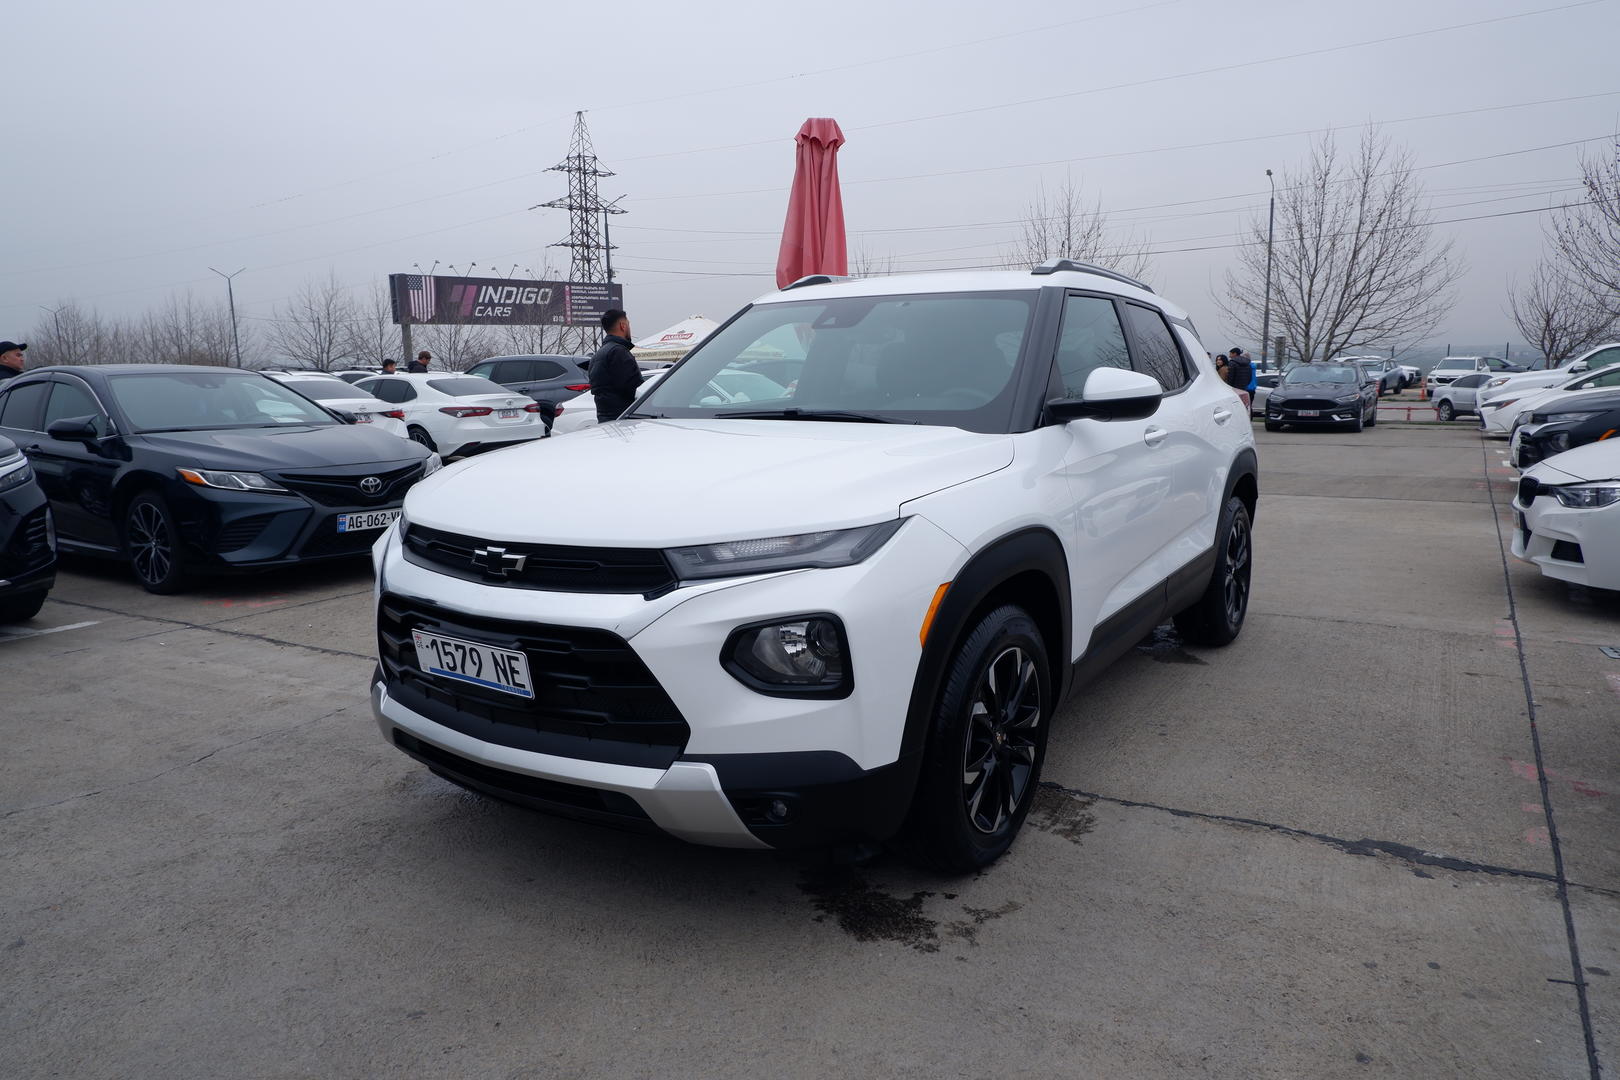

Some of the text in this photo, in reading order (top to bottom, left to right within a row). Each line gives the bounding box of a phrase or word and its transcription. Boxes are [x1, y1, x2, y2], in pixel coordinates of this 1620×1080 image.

[478, 285, 552, 304] INDIGO
[475, 306, 512, 317] CARS
[491, 651, 526, 689] NE
